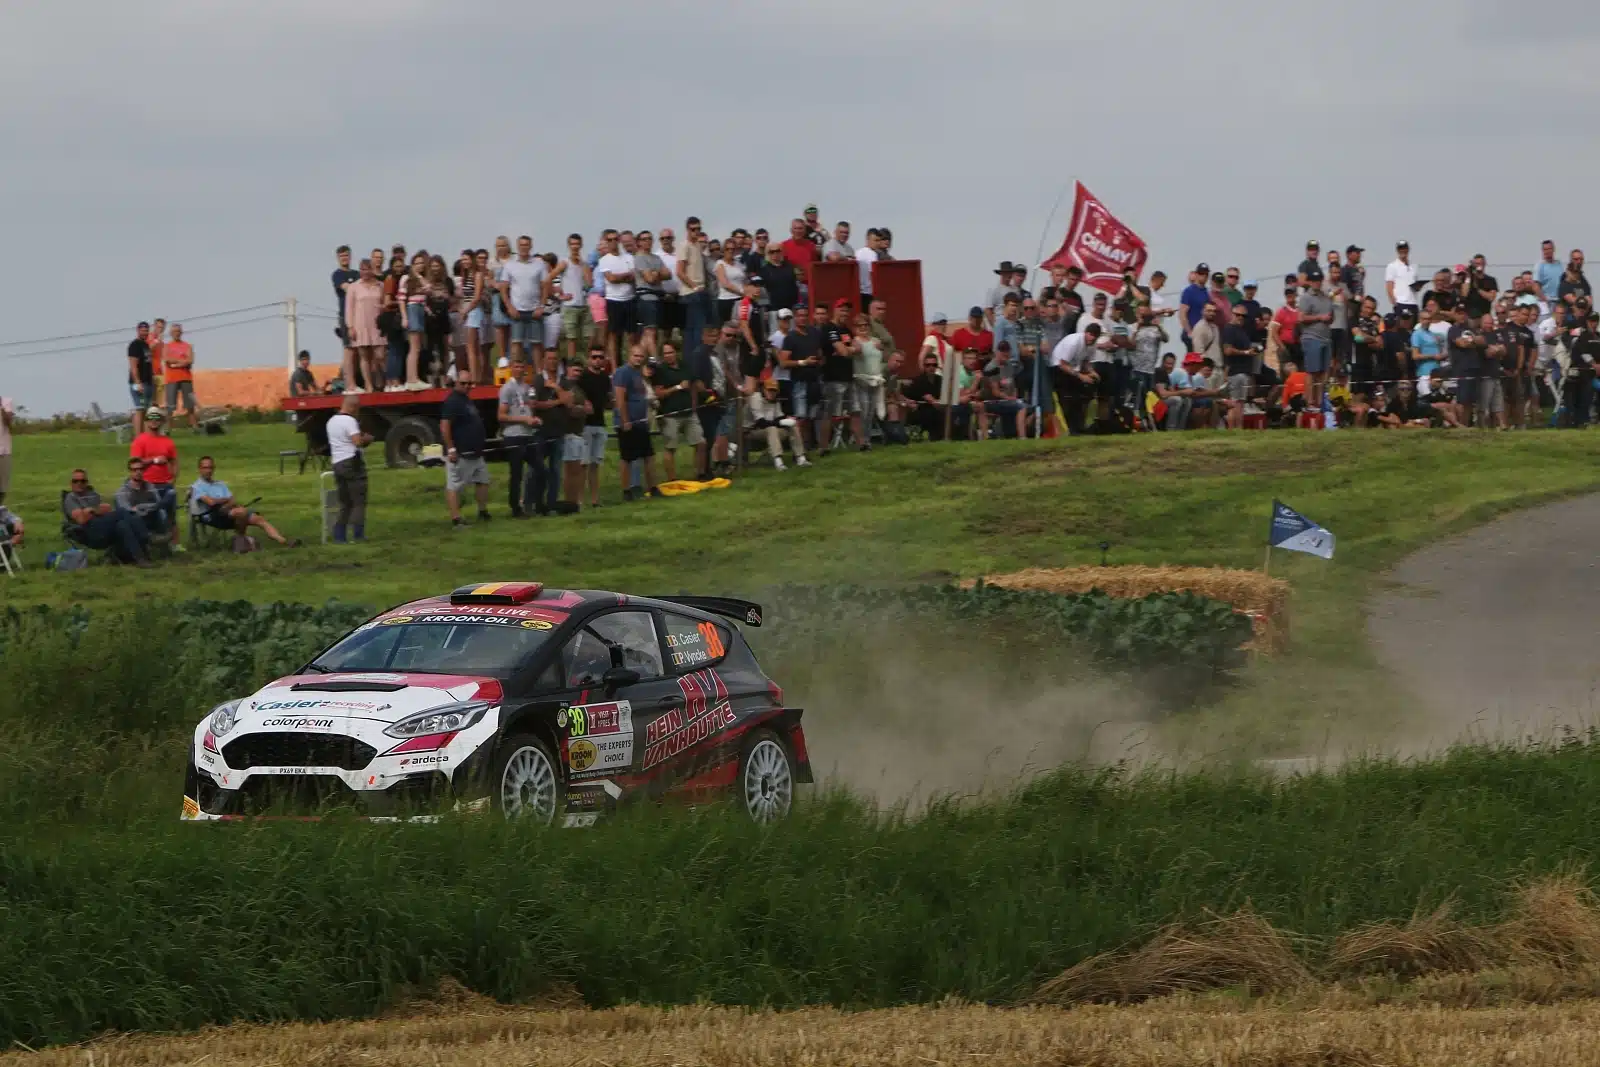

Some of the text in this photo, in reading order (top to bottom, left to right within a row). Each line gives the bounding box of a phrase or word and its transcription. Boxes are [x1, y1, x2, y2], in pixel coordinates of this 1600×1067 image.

[467, 606, 493, 614] ALL
[497, 608, 531, 617] LIVE
[421, 615, 509, 624] KROON-OIL
[672, 631, 701, 647] B. Casier
[697, 621, 725, 659] 38
[679, 648, 707, 665] P. Vyncke
[262, 717, 334, 729] colorpoint
[567, 707, 585, 737] 38
[645, 707, 683, 747] HEIN
[642, 700, 737, 771] VANHOUTTE
[597, 742, 607, 751] THE
[570, 749, 593, 759] KROON
[604, 752, 625, 763] CHOICE
[411, 755, 449, 765] ardeca
[575, 759, 586, 769] OIL
